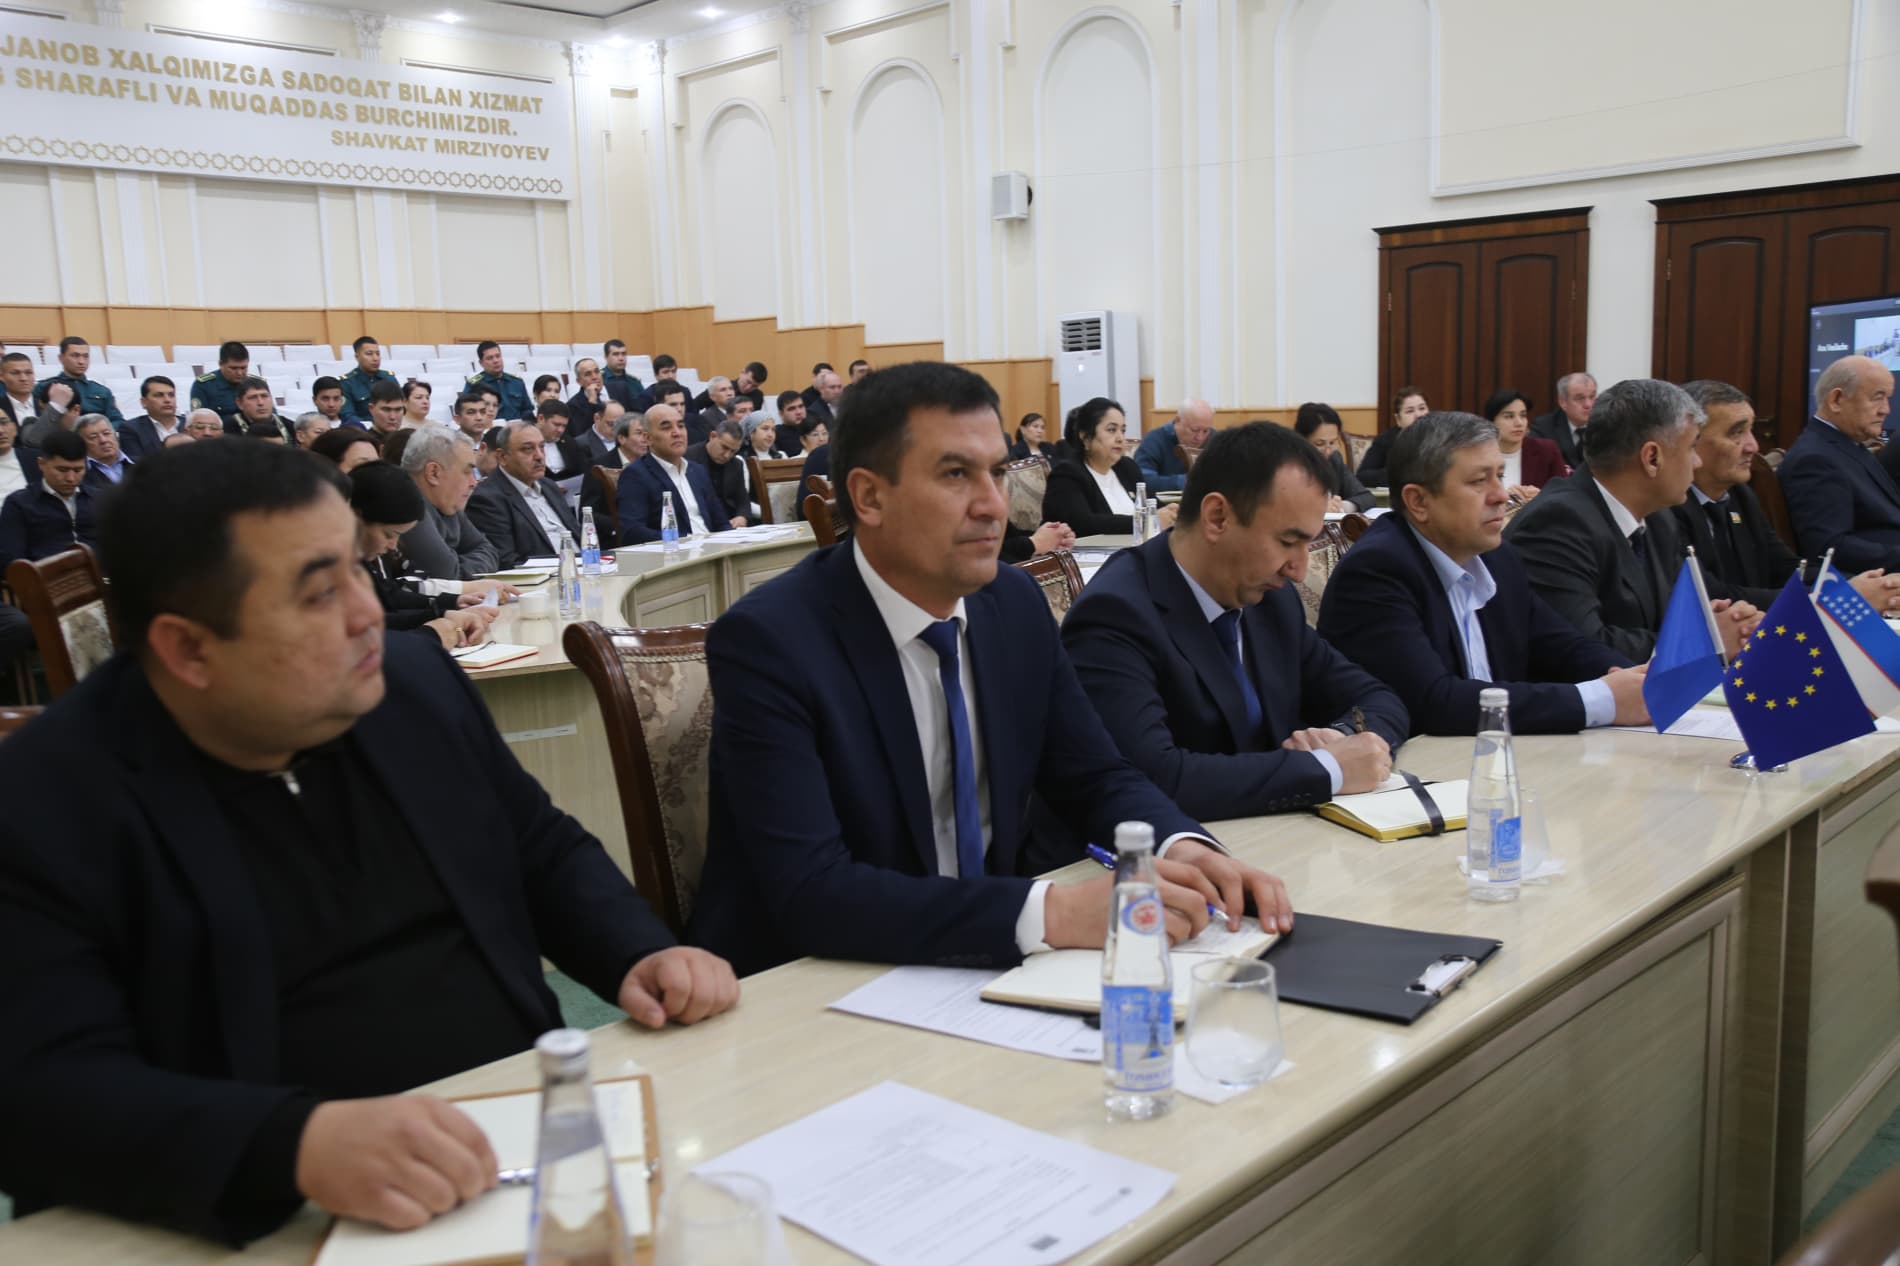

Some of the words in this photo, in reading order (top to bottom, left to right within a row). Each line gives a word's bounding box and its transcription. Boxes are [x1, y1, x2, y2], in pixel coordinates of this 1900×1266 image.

[16, 67, 157, 102] SHARAFLI
[165, 84, 202, 108] VA
[209, 89, 348, 121] MUQADDAS
[355, 104, 518, 136] BURCHIMIZDIR.
[108, 47, 275, 87] XALQIMIZGA
[282, 70, 390, 99] SADOQAT
[399, 83, 462, 106] BILAN
[469, 90, 543, 114] XIZMAT
[331, 129, 428, 152] SHAVKAT
[434, 138, 550, 161] MIRZIYOYEV
